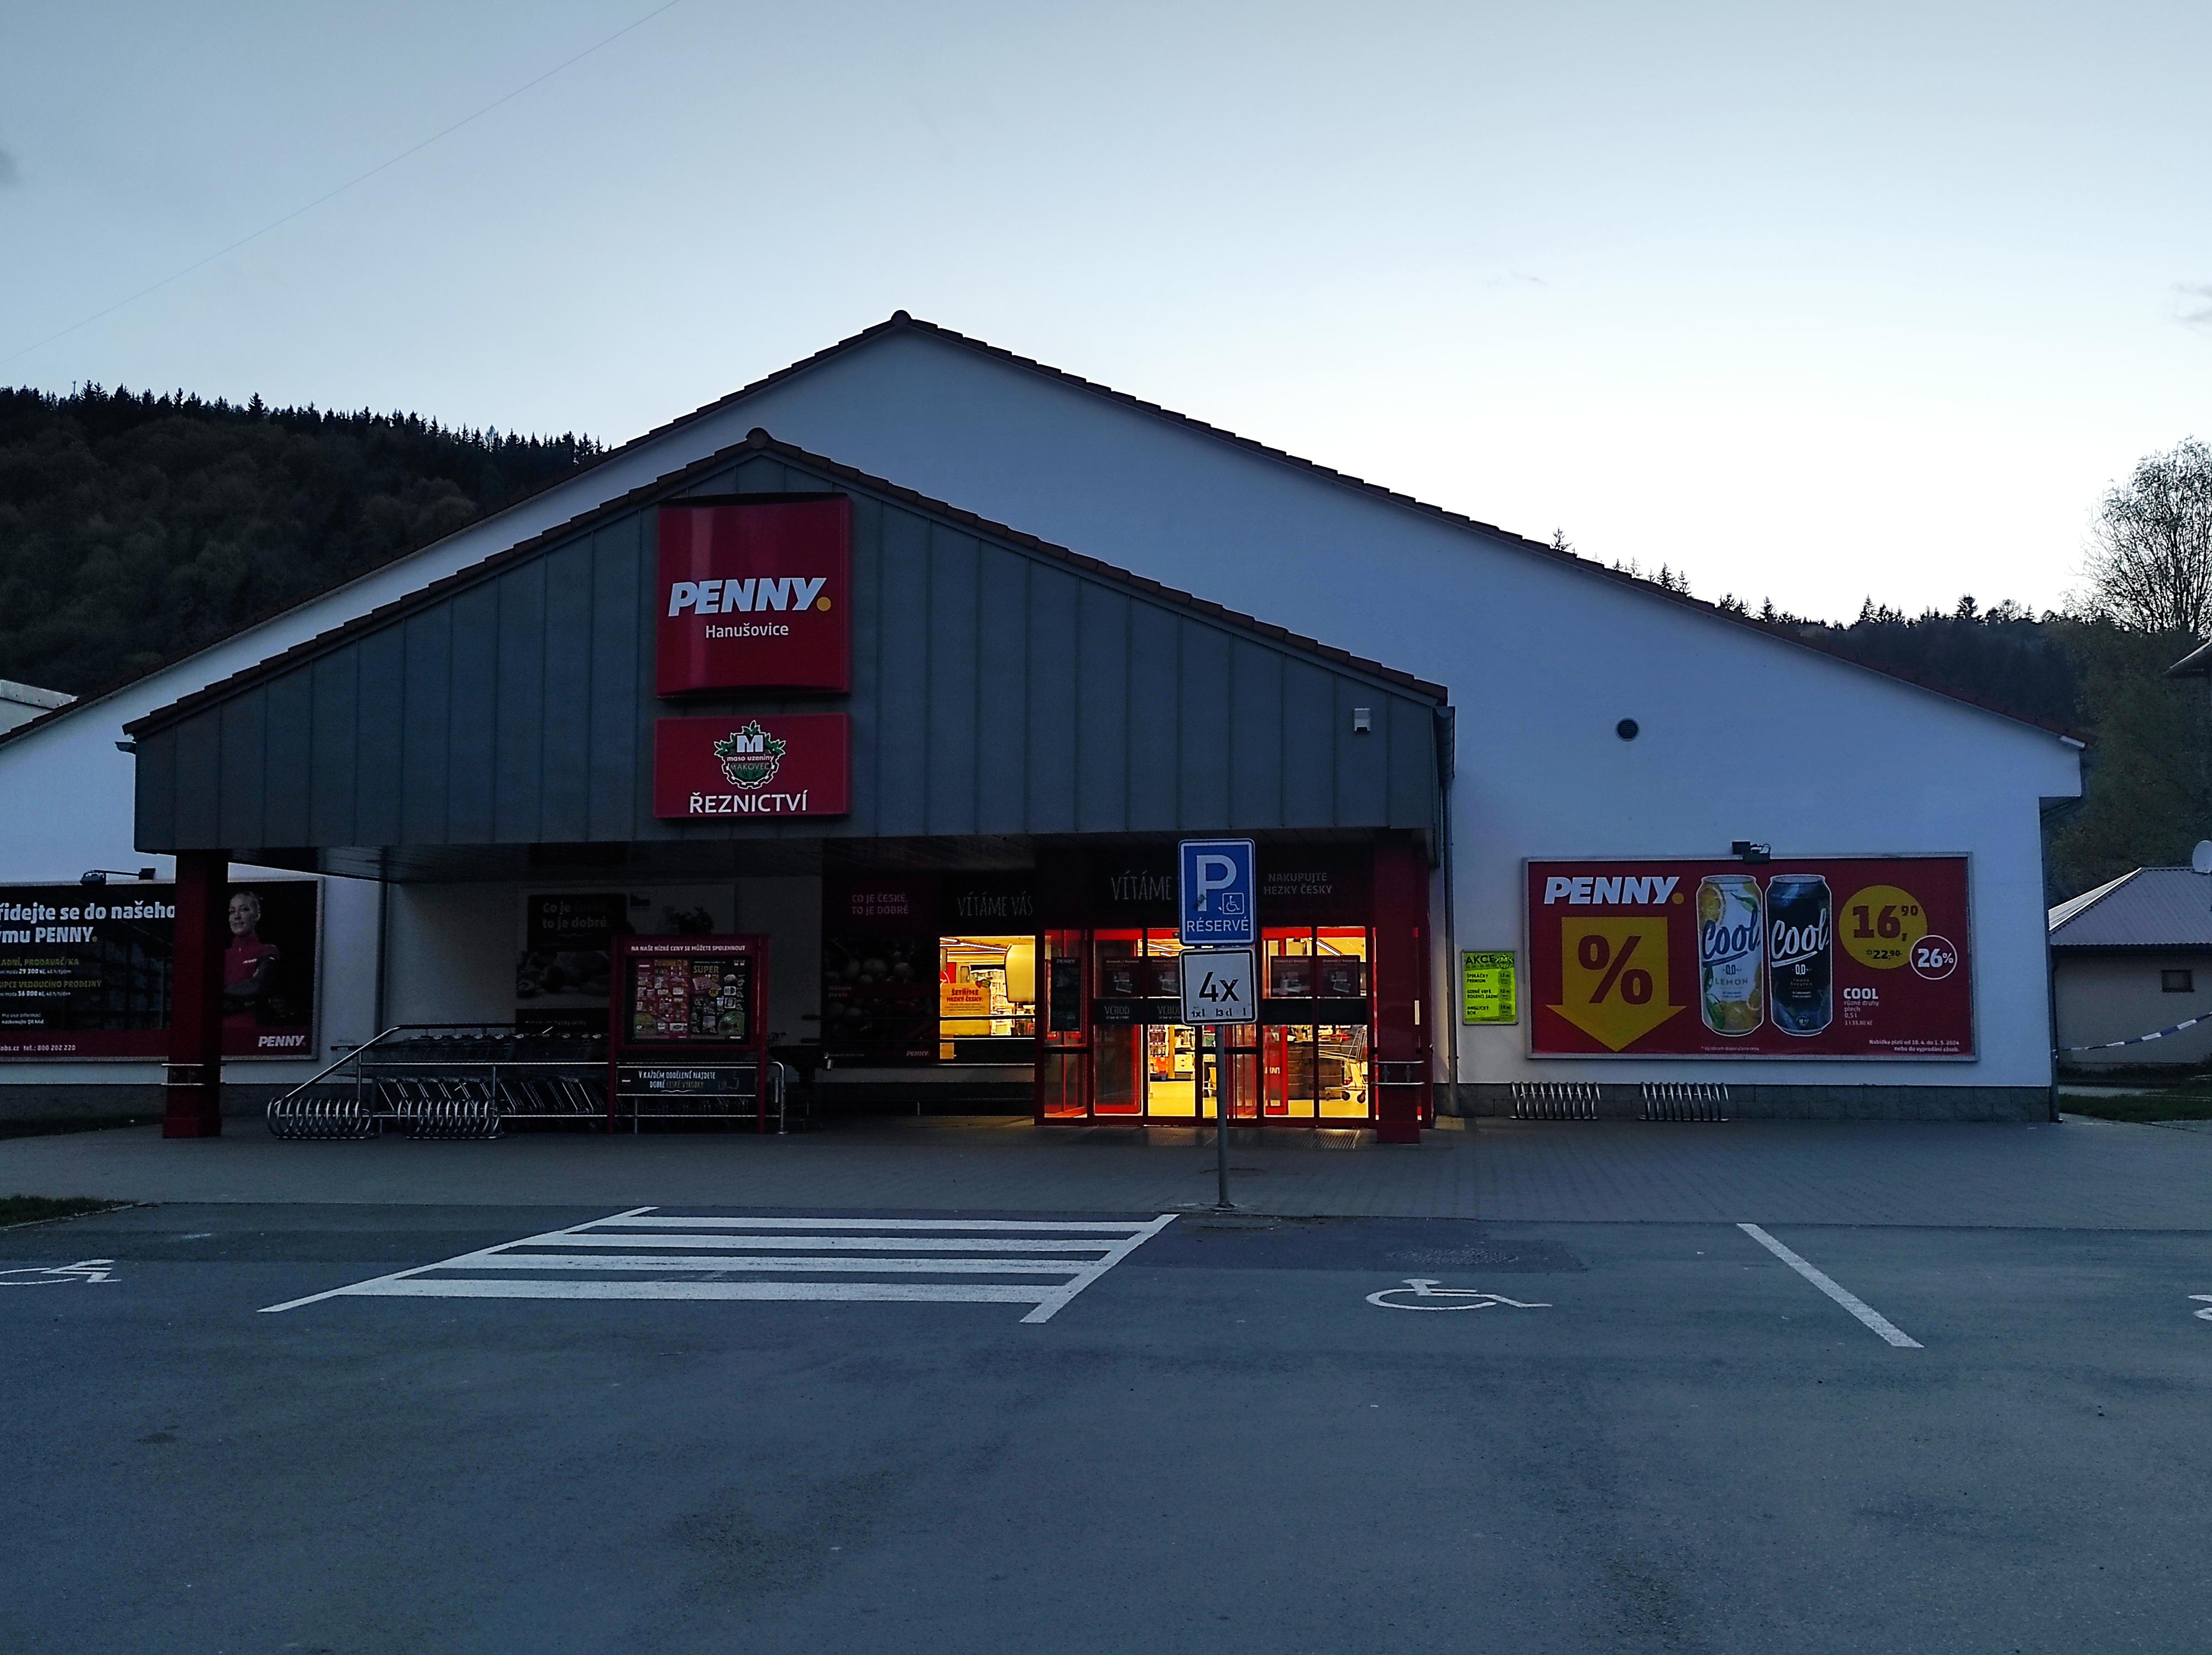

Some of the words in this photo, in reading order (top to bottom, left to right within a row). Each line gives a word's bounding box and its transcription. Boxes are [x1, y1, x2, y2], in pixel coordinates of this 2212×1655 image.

[706, 623, 789, 638] Hanušovice
[737, 735, 764, 753] M
[747, 754, 775, 763] uzeniny
[690, 791, 807, 813] ŘEZNICTVÍ
[1197, 855, 1237, 911] P
[1269, 873, 1327, 883] NAKUPUJTE
[1110, 870, 1172, 901] VÍTÁME
[1264, 885, 1297, 895] HEZKY
[1301, 884, 1332, 894] ČESKY
[852, 894, 864, 902] CO
[866, 894, 875, 904] JE
[957, 890, 1007, 916] VÍTÁME
[1011, 891, 1033, 916] VÁS
[60, 907, 80, 920] se
[85, 903, 107, 920] do
[852, 906, 863, 915] TO
[865, 906, 875, 916] JE
[877, 905, 909, 915] DOBRÉ
[1187, 916, 1250, 932] RÉSERVÉ
[1466, 954, 1495, 964] AKCE
[693, 965, 719, 974] SUPER
[1199, 972, 1239, 1003] 4x
[1843, 988, 1879, 999] COOL
[1104, 1005, 1130, 1014] VCHOD
[643, 1070, 664, 1079] KAŽDÉM
[666, 1070, 692, 1079] ODDĚLENÍ
[693, 1071, 716, 1079] NAJDETE
